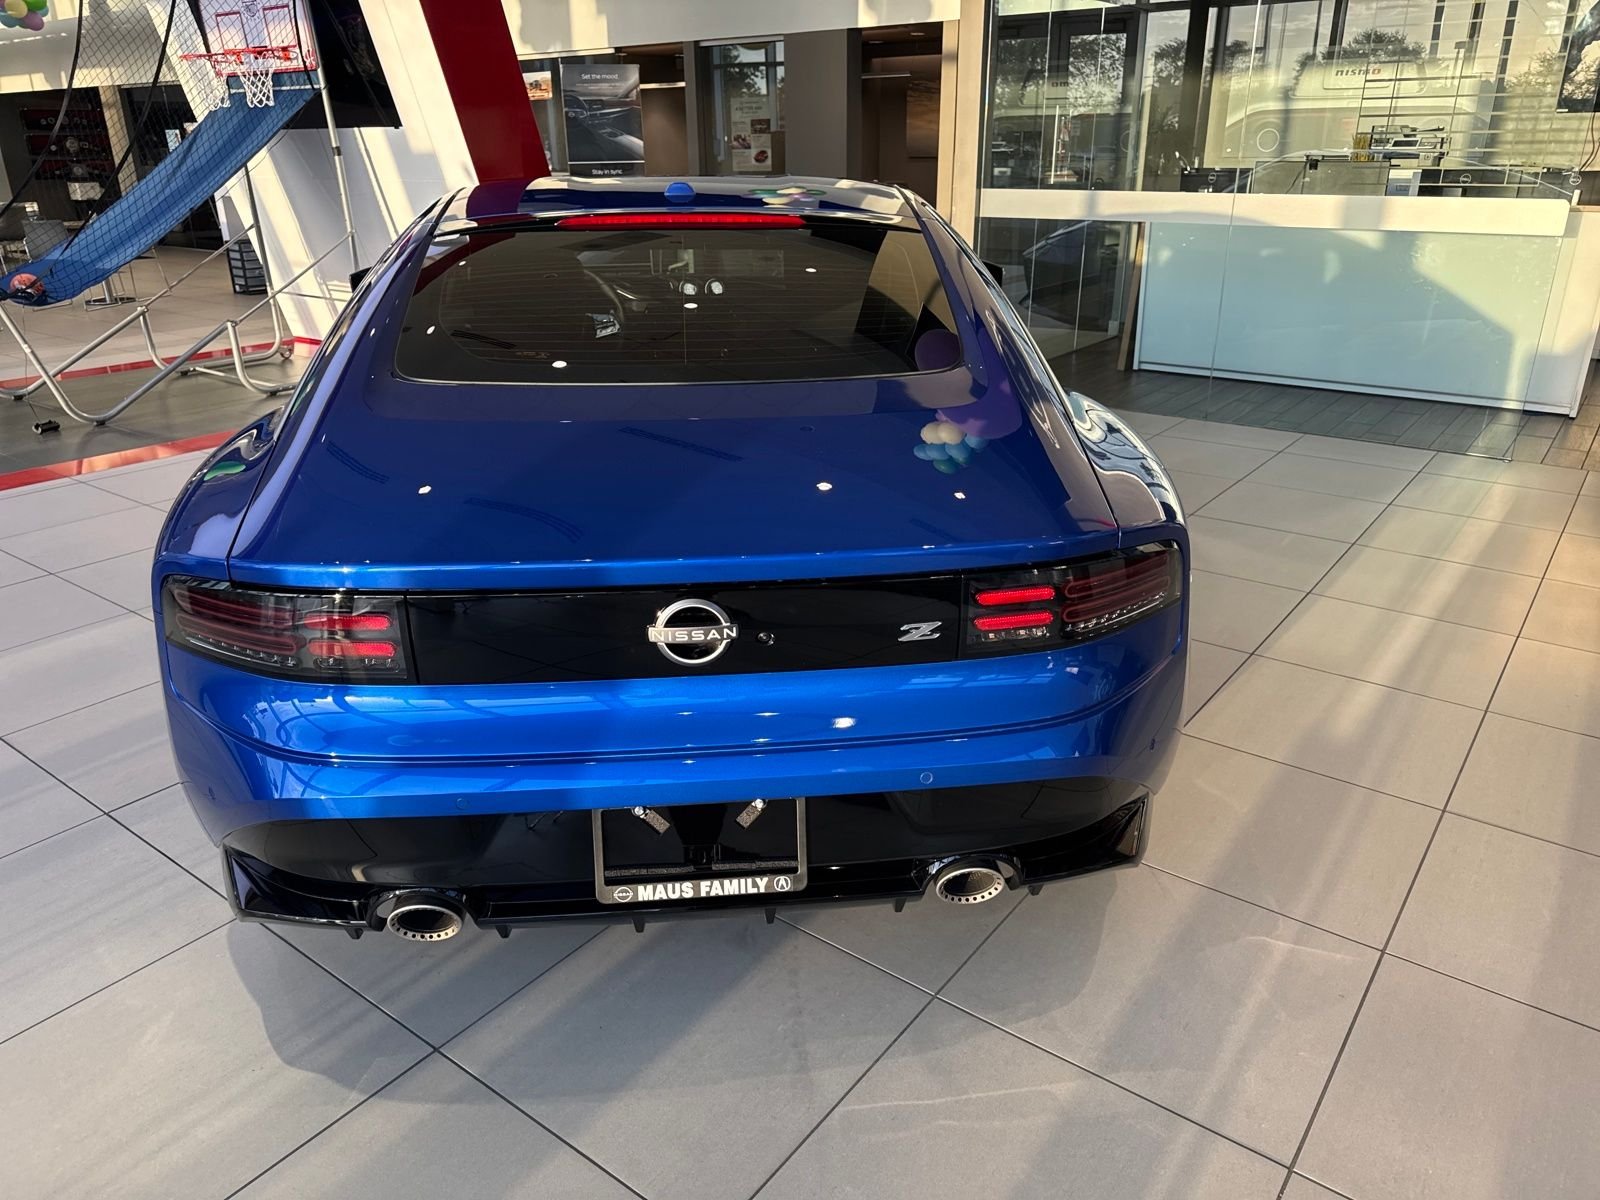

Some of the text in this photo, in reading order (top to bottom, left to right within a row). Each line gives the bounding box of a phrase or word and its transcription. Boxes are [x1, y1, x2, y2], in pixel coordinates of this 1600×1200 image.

[651, 626, 737, 642] NISSAN
[897, 621, 942, 642] Z
[638, 877, 768, 901] MAUS FAMILY
